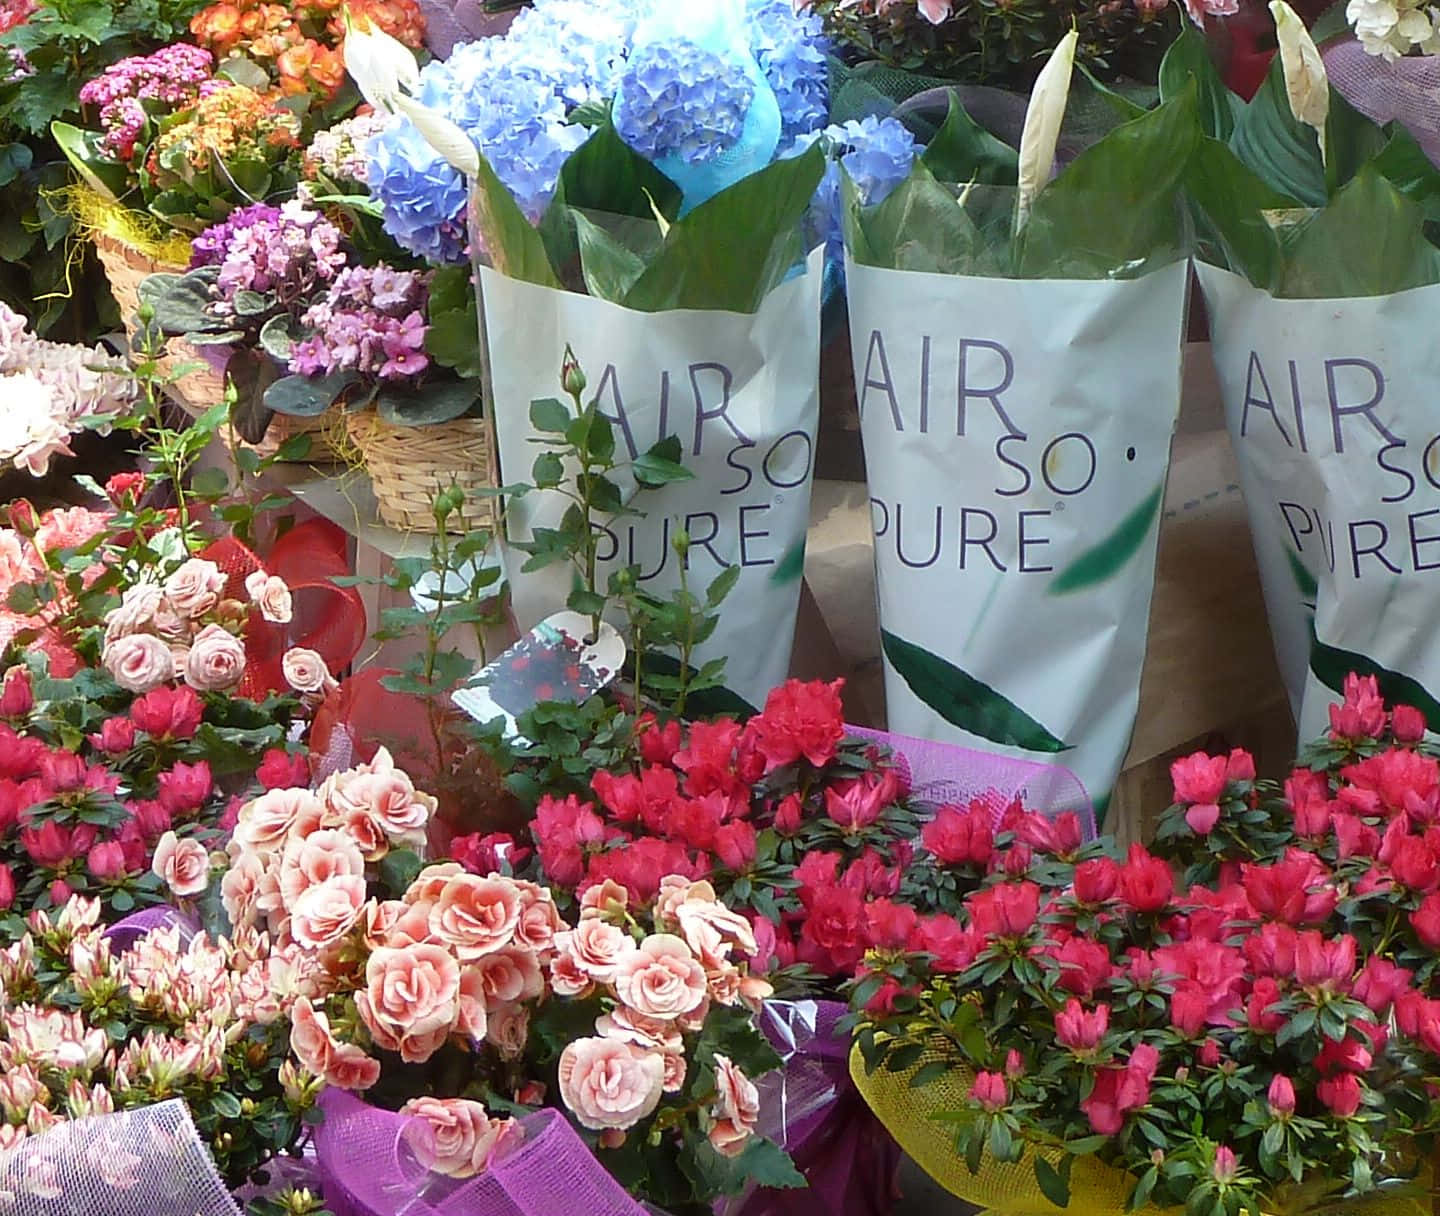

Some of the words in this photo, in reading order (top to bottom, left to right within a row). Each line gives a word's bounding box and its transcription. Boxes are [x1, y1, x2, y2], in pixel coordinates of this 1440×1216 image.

[590, 361, 757, 460] AIR
[860, 329, 1027, 437] AIR
[1240, 350, 1407, 454] AIR
[719, 429, 812, 495] SO
[994, 432, 1097, 497] SO
